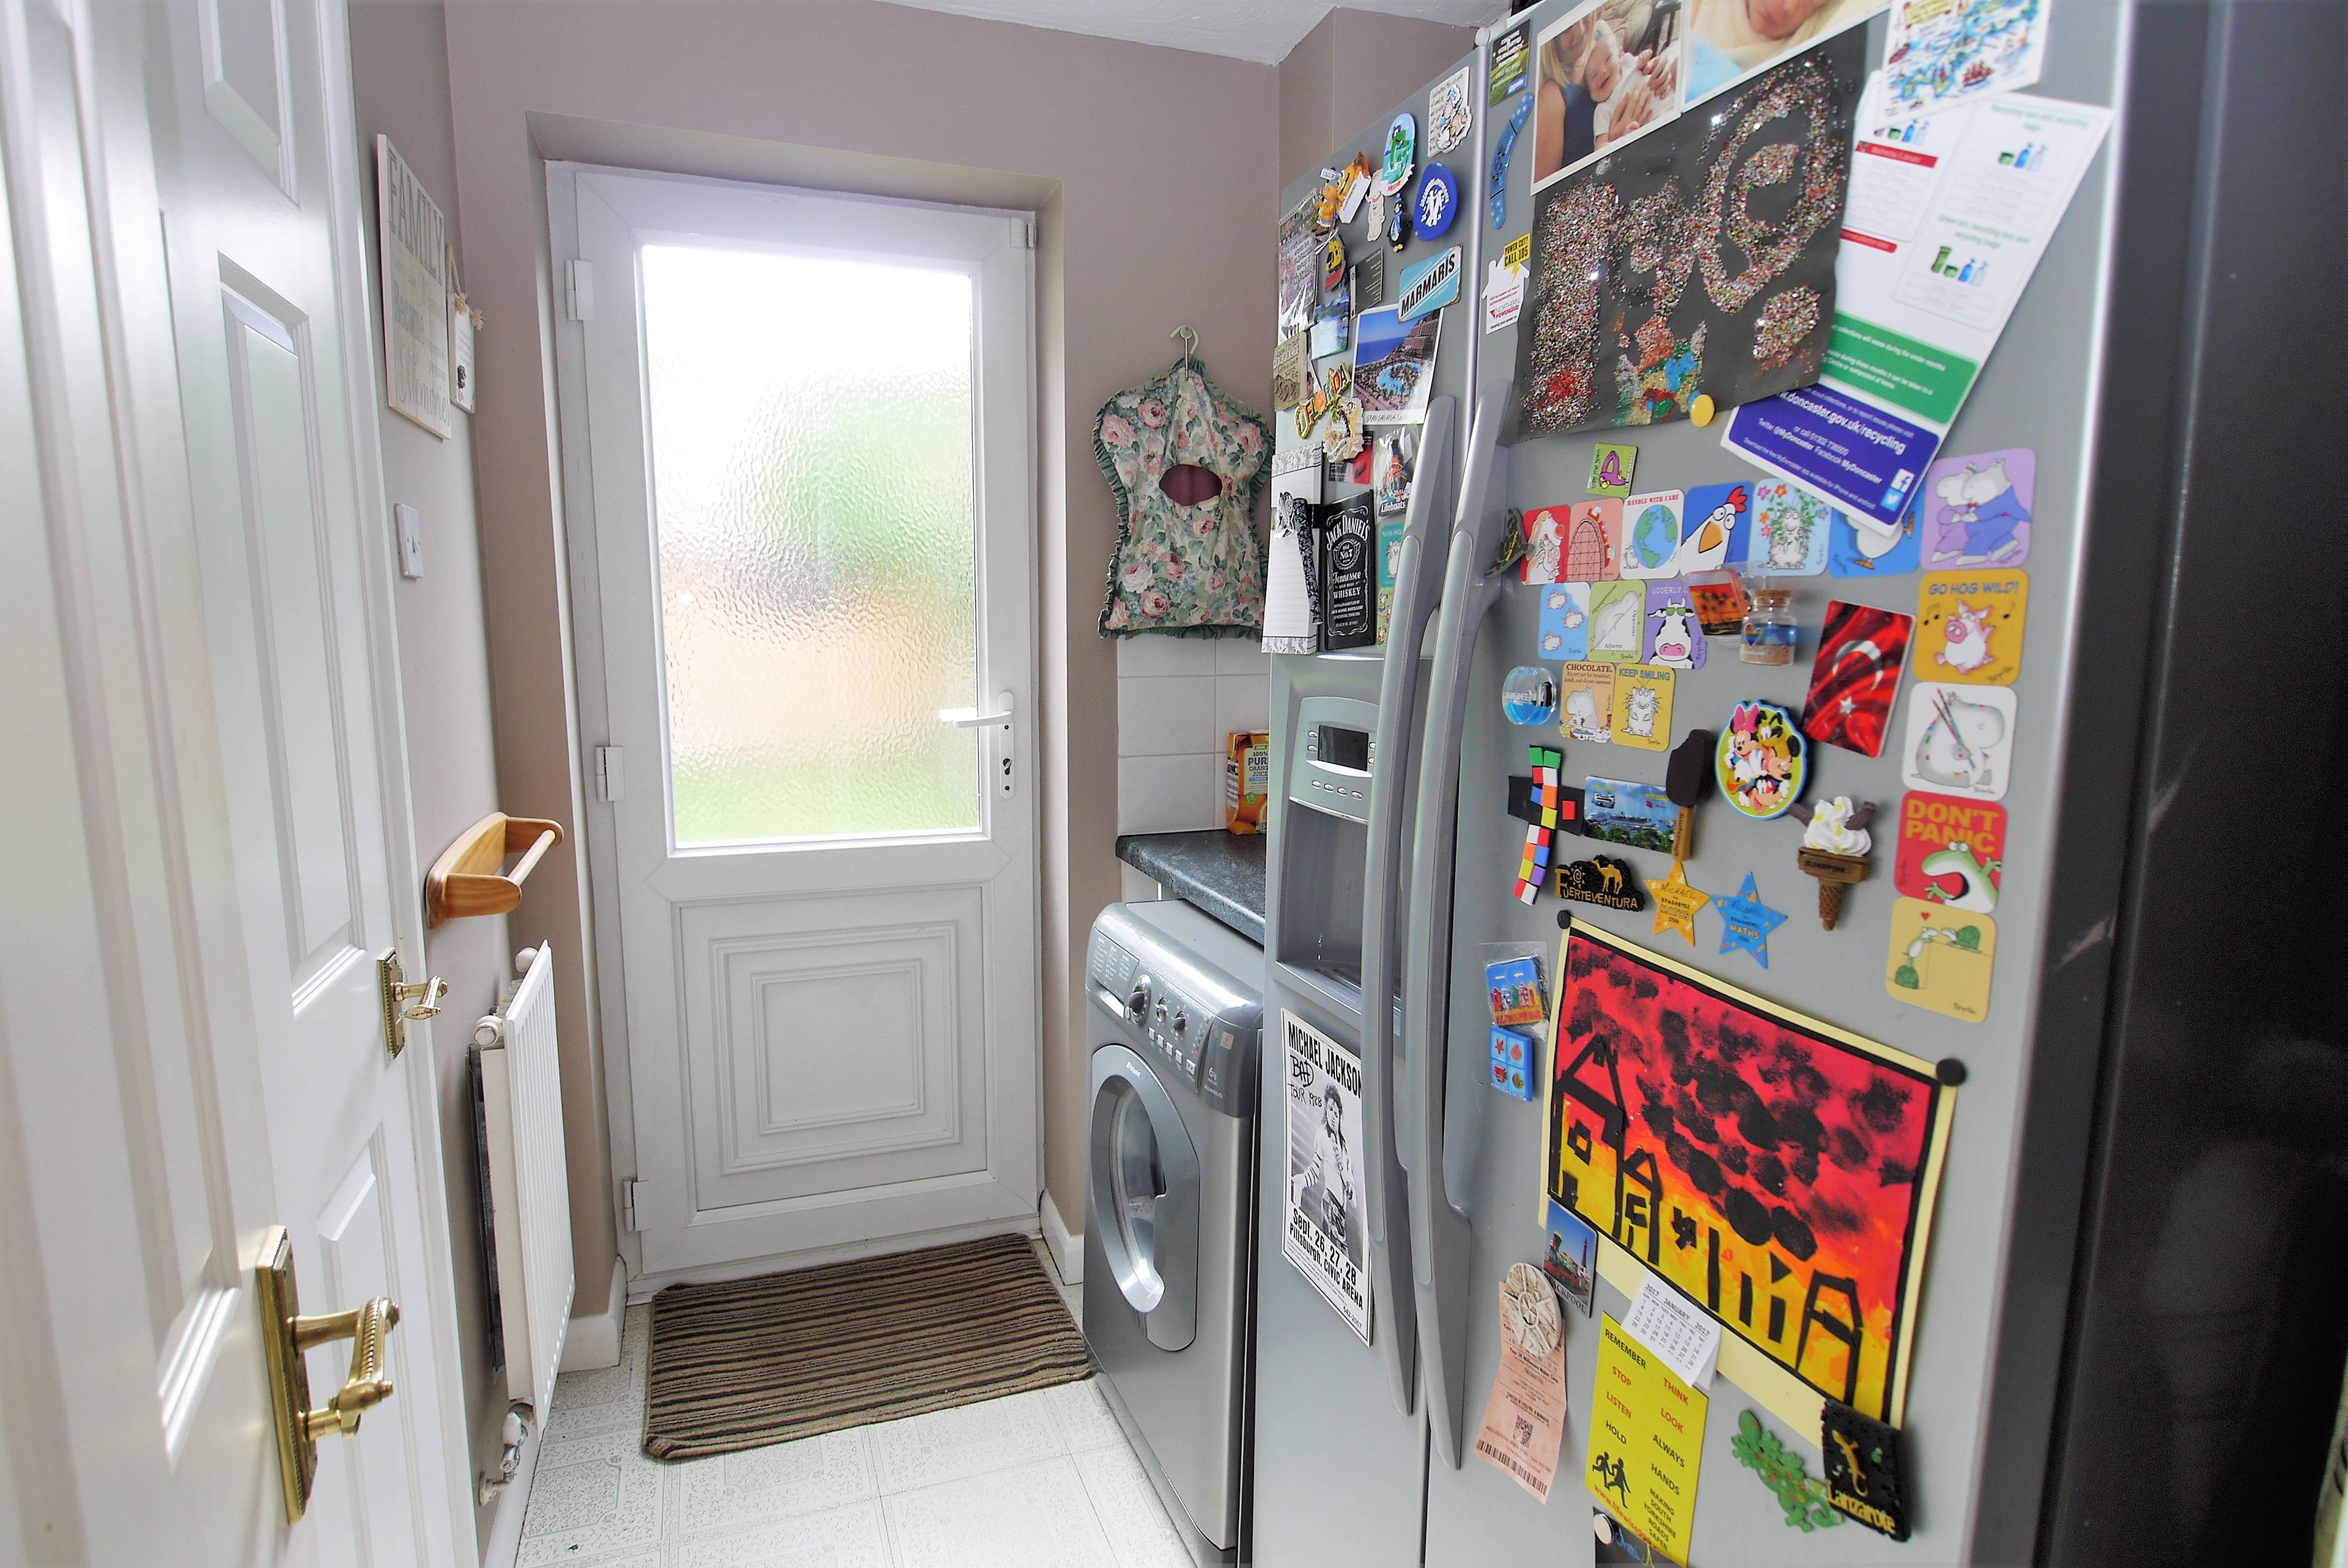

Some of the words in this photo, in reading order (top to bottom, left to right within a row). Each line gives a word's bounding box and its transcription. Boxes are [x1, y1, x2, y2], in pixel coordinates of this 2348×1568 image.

[389, 147, 444, 286] FAMILY
[1505, 243, 1518, 255] POWER
[1505, 252, 1516, 267] CALL
[1518, 246, 1528, 260] 105
[1496, 305, 1519, 318] POWERGRID
[1381, 501, 1405, 513] Lifeboats
[1326, 521, 1341, 551] JACK
[1342, 515, 1370, 543] DANIEL'S
[1333, 571, 1361, 584] Tennessee
[1333, 587, 1361, 599] WHISKEY
[1929, 583, 1947, 595] GO
[1951, 583, 1978, 595] HOG
[1983, 581, 2019, 594] WILD!
[1567, 664, 1612, 672] CHOCOLATE.
[1619, 668, 1637, 677] KEEP
[1640, 670, 1671, 680] SMILING
[1907, 798, 1999, 832] DON'T
[1675, 812, 1684, 856] Scarborough
[1905, 819, 1995, 853] PANIC
[1555, 868, 1638, 908] FUERTEVENTURA
[1730, 924, 1760, 939] MATHS
[1288, 1021, 1323, 1070] MICHAEL
[1290, 1055, 1314, 1088] BAD
[1287, 1083, 1307, 1105] TOUR
[1293, 1208, 1312, 1241] Sept.
[1315, 1230, 1327, 1256] 26,
[1345, 1262, 1357, 1286] 28
[1324, 1258, 1340, 1285] CIVIC
[1342, 1278, 1363, 1310] ARENA
[1645, 1283, 1659, 1297] 2017
[1663, 1298, 1690, 1320] JANUARY
[1695, 1322, 1710, 1336] 2017
[1604, 1329, 1647, 1369] REMEMBER
[1612, 1366, 1633, 1388] STOP
[1663, 1377, 1689, 1406] THINK
[1606, 1390, 1632, 1419] LISTEN
[1661, 1408, 1683, 1434] LOOK
[1606, 1419, 1627, 1445] HOLD
[1653, 1435, 1686, 1468] ALWAYS
[1651, 1463, 1680, 1496] HANDS
[1650, 1488, 1674, 1516] MAKING
[1651, 1500, 1671, 1523] SOUTH
[1826, 1478, 1896, 1534] Lanzarote
[1644, 1502, 1676, 1539] YORKSHIRE
[1648, 1517, 1669, 1542] ROADS
[1649, 1528, 1667, 1551] SAFER
